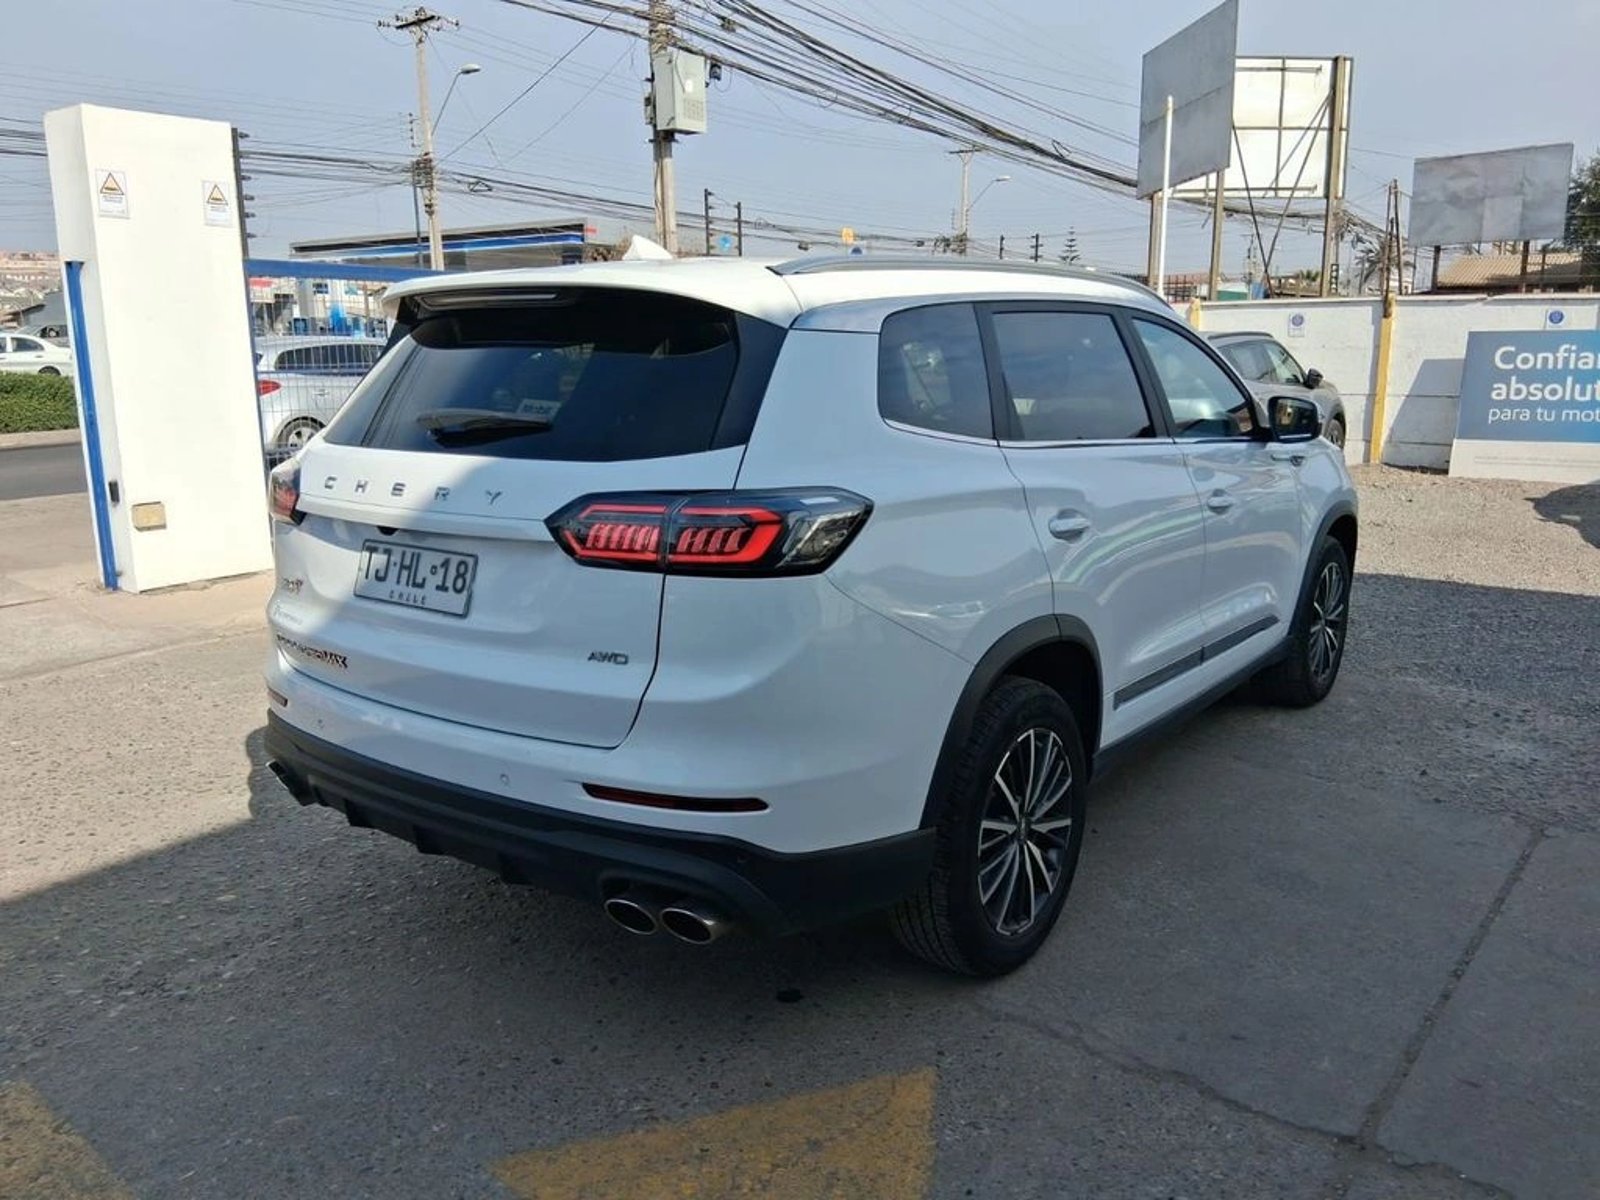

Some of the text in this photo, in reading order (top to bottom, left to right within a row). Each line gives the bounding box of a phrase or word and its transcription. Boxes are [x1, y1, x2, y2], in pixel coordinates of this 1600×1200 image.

[1494, 344, 1600, 370] Confia
[1488, 407, 1531, 424] para
[1537, 406, 1556, 422] tu
[324, 475, 503, 506] CHERY
[587, 650, 629, 666] AWD
